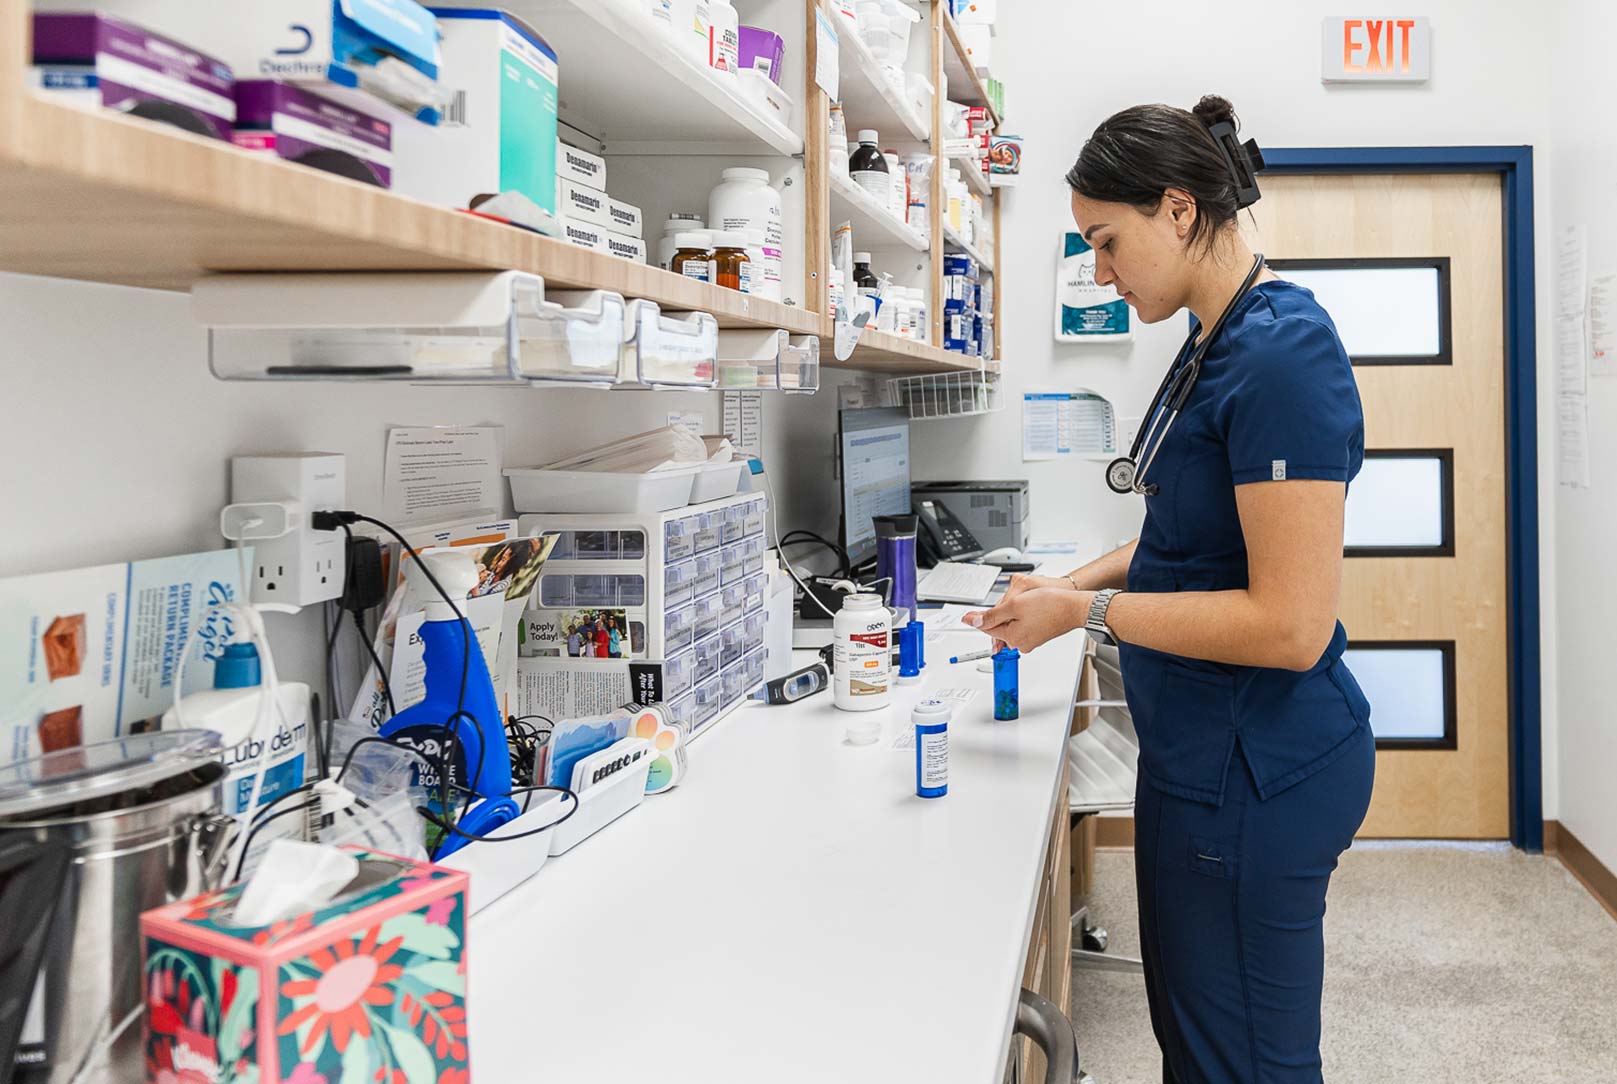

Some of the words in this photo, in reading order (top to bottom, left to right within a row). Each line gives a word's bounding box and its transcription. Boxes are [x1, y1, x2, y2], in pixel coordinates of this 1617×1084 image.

[1343, 19, 1415, 74] EXIT
[566, 152, 597, 173] Denamarin
[570, 189, 600, 209] Denamarin
[610, 205, 635, 222] Denamarin
[566, 225, 598, 244] Denamarin
[608, 238, 638, 256] Denamarin
[166, 584, 179, 630] RETURN
[530, 622, 554, 632] Apply
[531, 632, 558, 641] Today!
[161, 634, 174, 688] PACKAGE
[418, 775, 456, 786] BOAD
